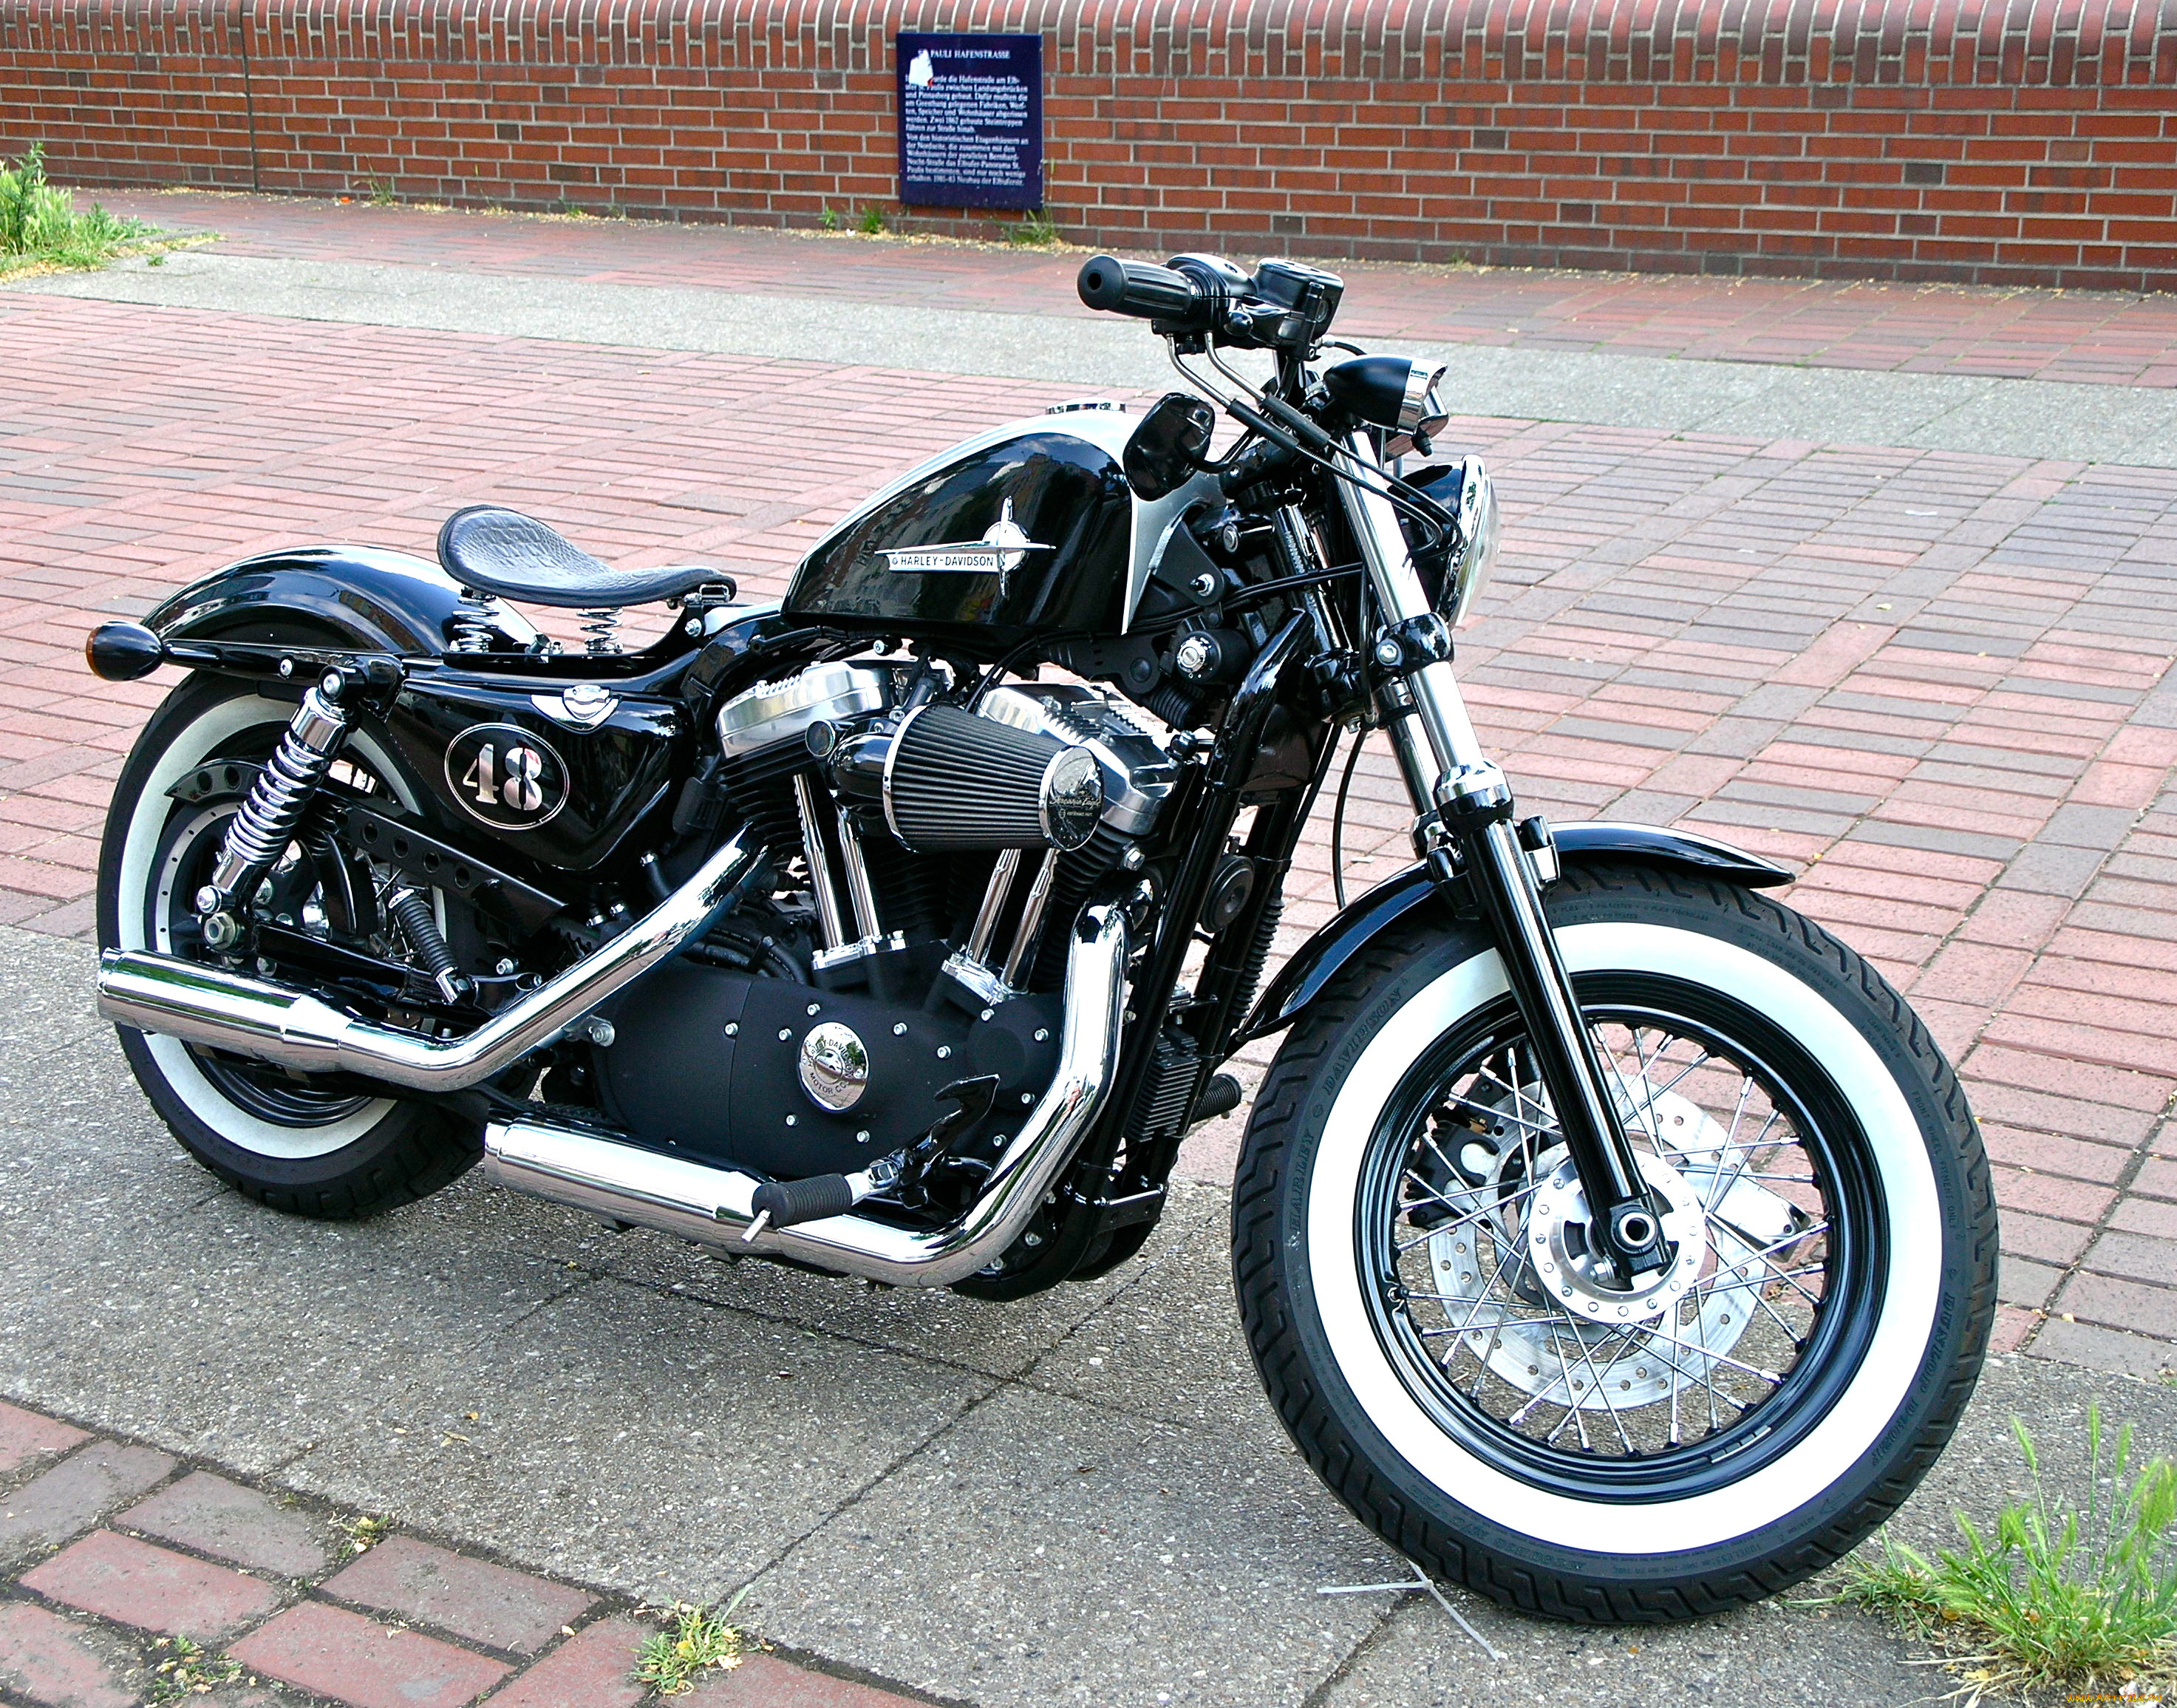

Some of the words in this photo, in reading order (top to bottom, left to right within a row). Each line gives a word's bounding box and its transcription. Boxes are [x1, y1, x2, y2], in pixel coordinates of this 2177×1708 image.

[930, 50, 952, 58] PAULI
[954, 50, 1010, 59] HAFENSTRASSE
[900, 556, 993, 567] HARLEY-DAVIDSON
[463, 744, 542, 811] 48
[810, 1072, 834, 1095] MOTOR
[1290, 1131, 1315, 1231] HARLEY
[1323, 987, 1402, 1096] DAVIDSON
